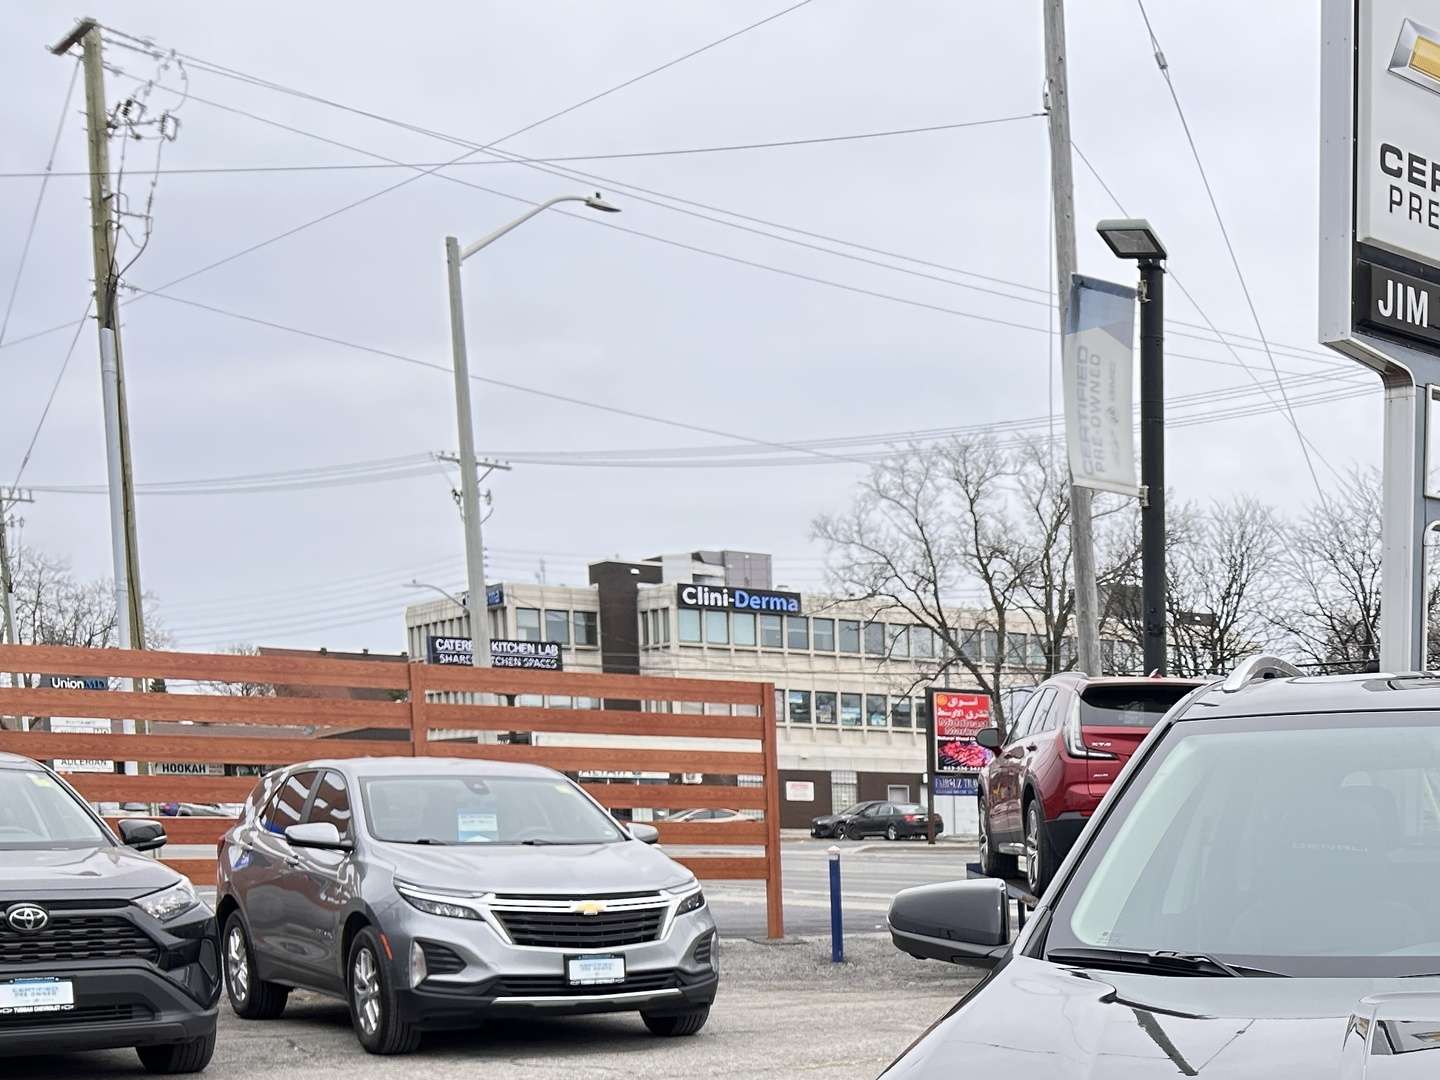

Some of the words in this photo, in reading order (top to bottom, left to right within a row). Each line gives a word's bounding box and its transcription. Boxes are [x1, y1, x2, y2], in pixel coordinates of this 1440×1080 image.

[1378, 279, 1428, 328] JIM
[1076, 345, 1094, 475] CERTIFIED
[682, 586, 799, 612] Clini-Derma
[435, 638, 473, 651] CATER
[491, 641, 535, 654] KITCHEN
[538, 643, 559, 656] LAB
[439, 654, 473, 665] SHARE
[162, 763, 206, 774] HOOKAH
